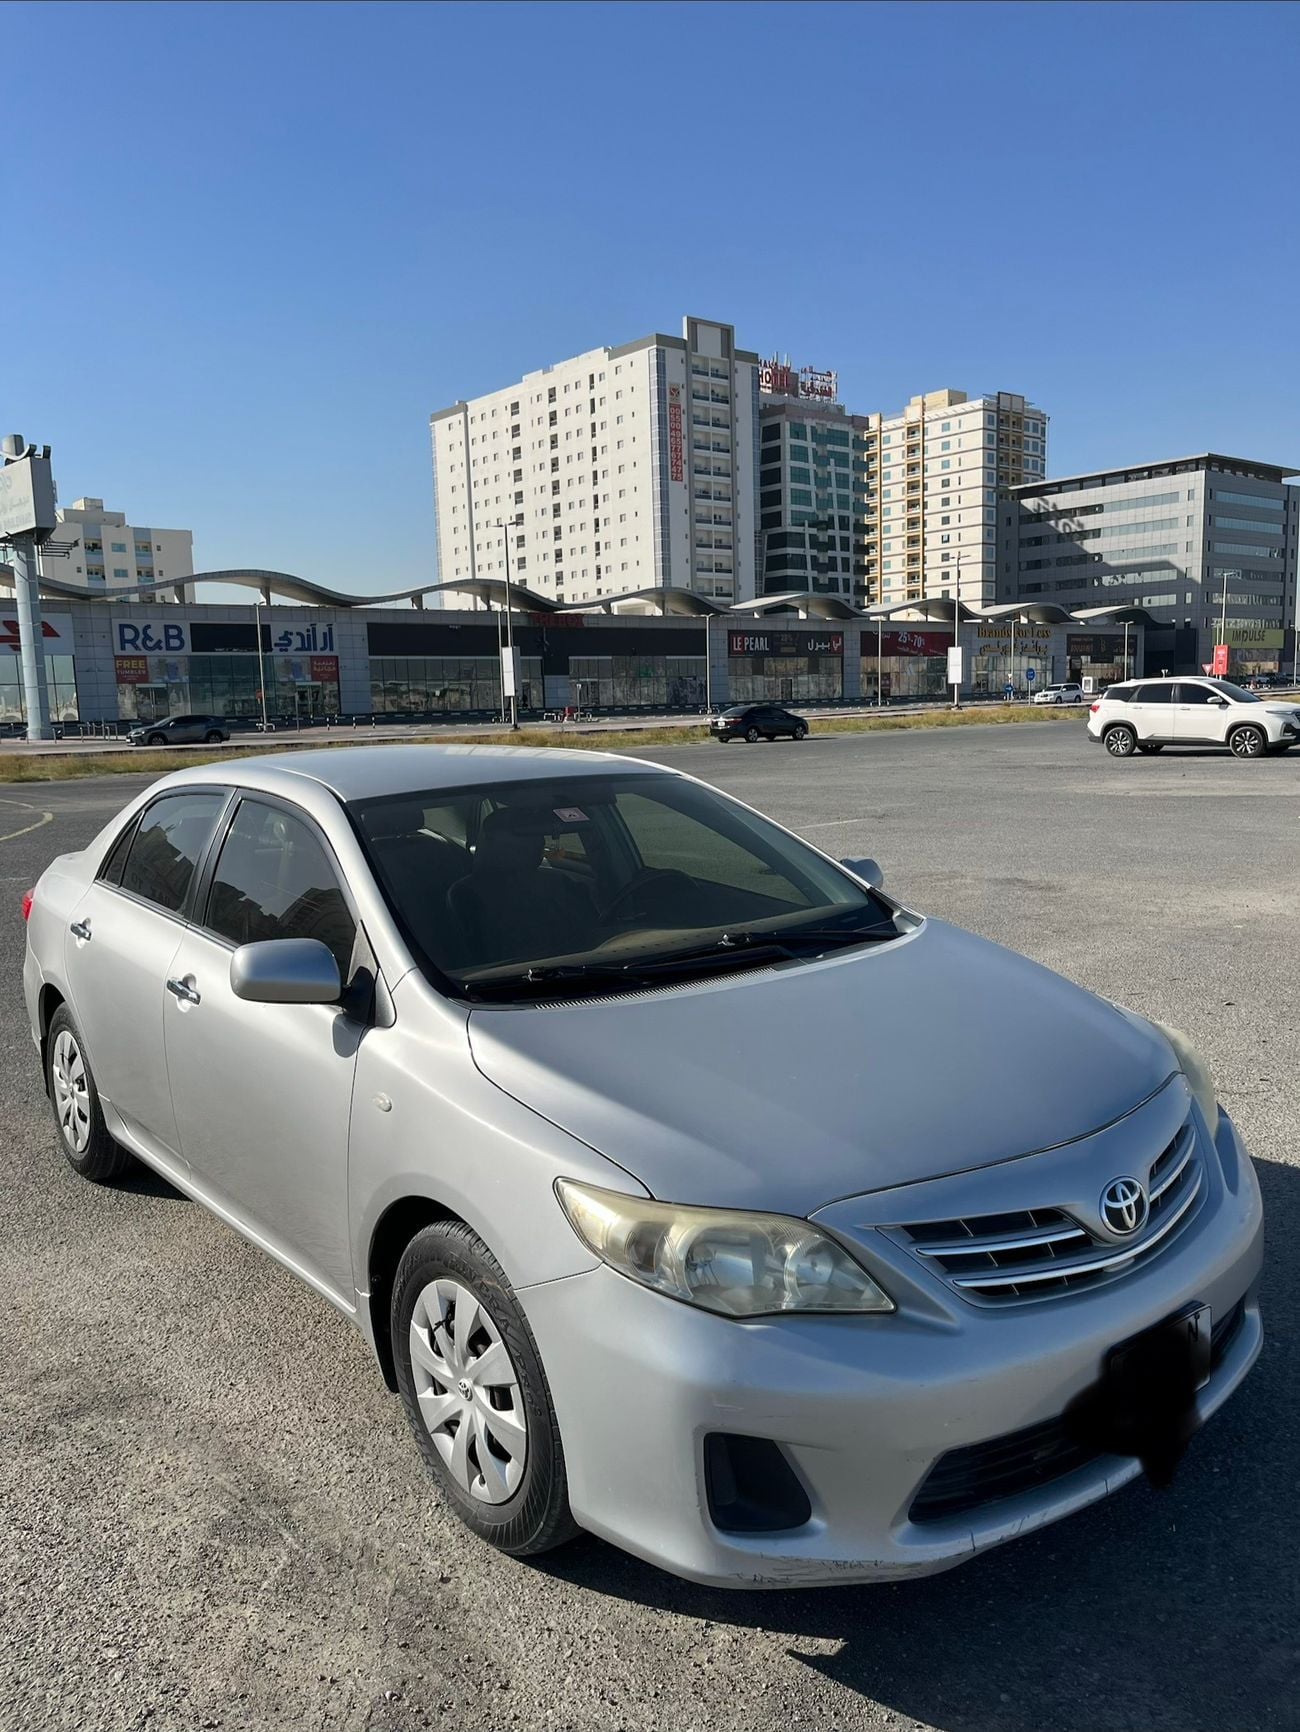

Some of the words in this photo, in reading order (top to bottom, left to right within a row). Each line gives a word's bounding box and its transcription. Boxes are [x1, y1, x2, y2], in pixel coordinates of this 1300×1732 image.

[118, 623, 186, 652] R&B
[1231, 630, 1266, 642] IMPULSE
[733, 637, 742, 651] LE
[744, 637, 770, 651] PEARL
[115, 659, 146, 669] FREE
